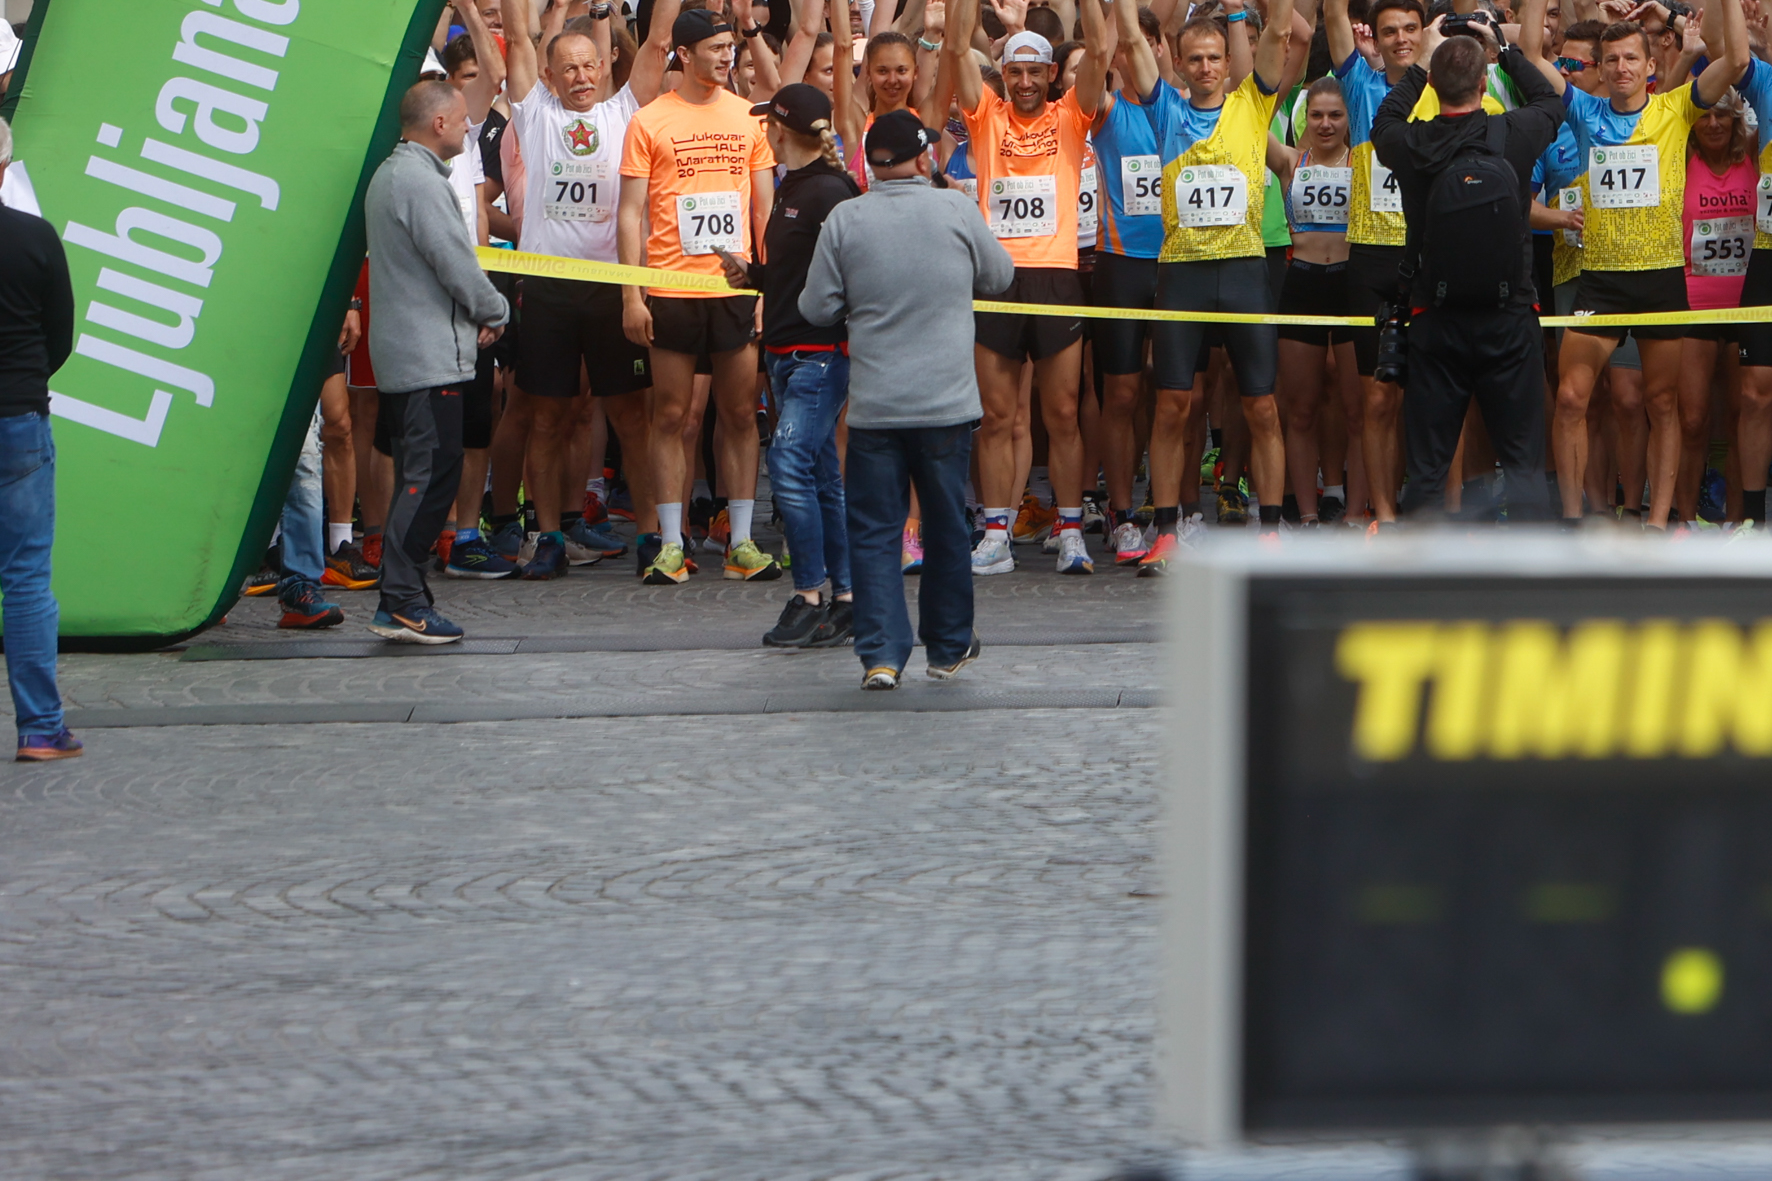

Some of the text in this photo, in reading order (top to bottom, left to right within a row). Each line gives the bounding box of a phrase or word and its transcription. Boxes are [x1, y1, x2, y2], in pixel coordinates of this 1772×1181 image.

[676, 156, 745, 167] Marathon
[1609, 151, 1618, 160] Pot
[565, 163, 574, 173] Pot
[575, 163, 583, 173] ob
[1144, 159, 1152, 169] Pot
[677, 169, 695, 178] 20
[1198, 170, 1206, 179] Pot
[1600, 168, 1646, 190] 417
[555, 181, 598, 204] 701
[1007, 181, 1015, 190] Pot
[1016, 180, 1024, 189] ob
[1188, 186, 1234, 209] 417
[1303, 185, 1347, 207] 565
[1699, 192, 1748, 208] bovha
[999, 197, 1045, 220] 708
[691, 213, 735, 236] 708
[1704, 238, 1746, 261] 553
